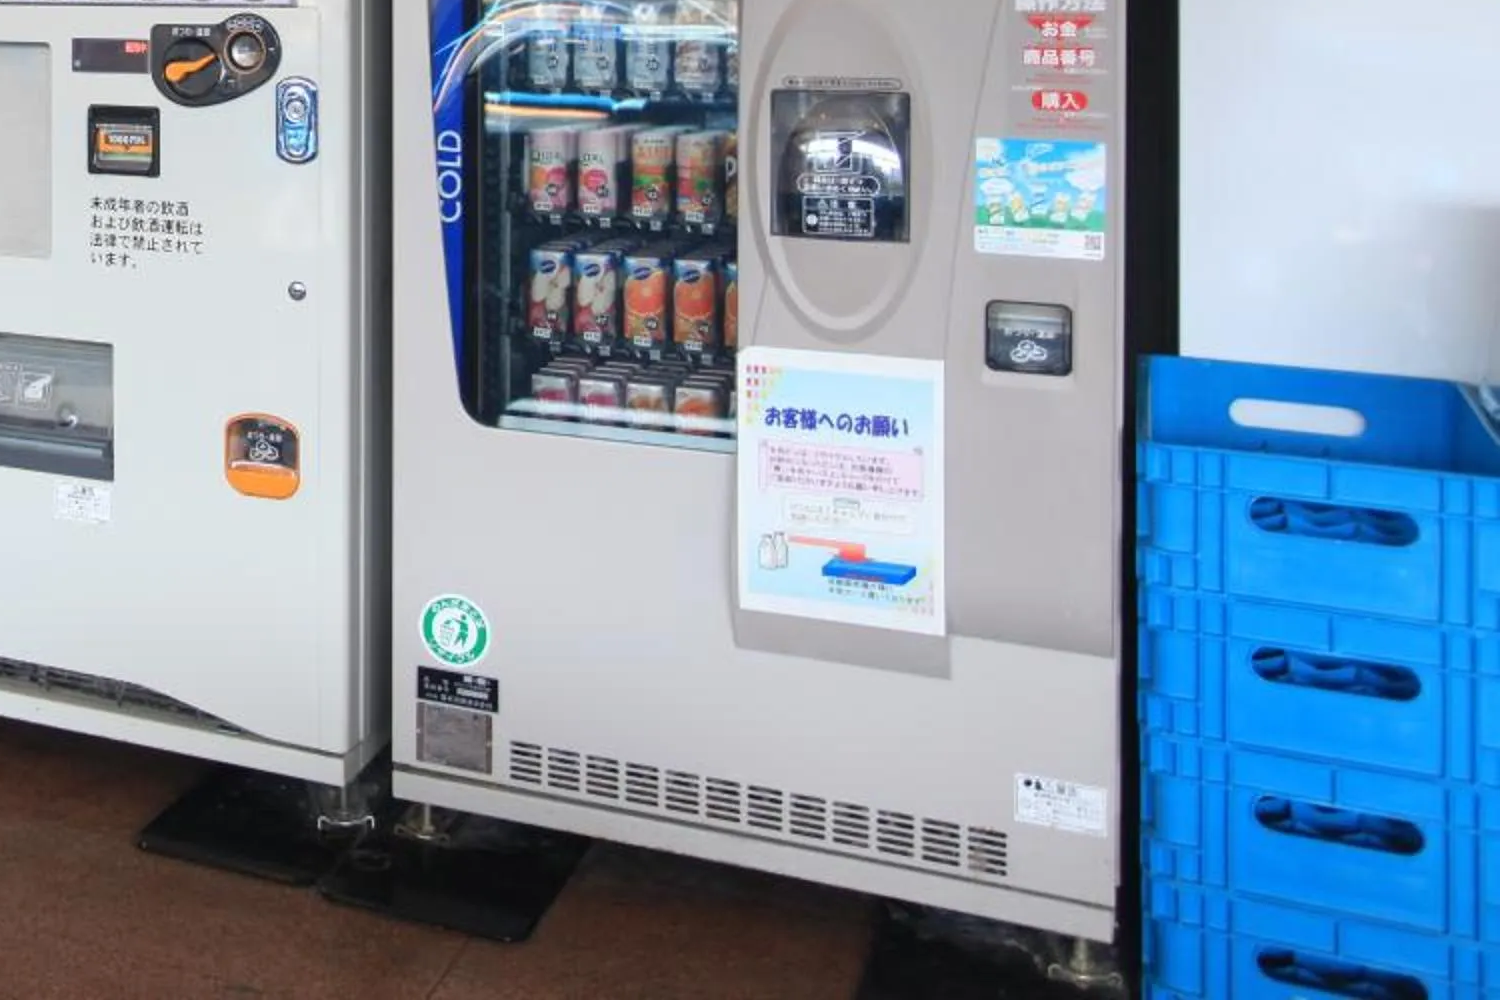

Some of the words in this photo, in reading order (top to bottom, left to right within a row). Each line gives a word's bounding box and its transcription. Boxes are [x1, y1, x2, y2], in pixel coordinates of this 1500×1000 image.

[1041, 20, 1077, 37] お金
[1023, 48, 1095, 66] 商品番号
[1041, 91, 1080, 109] 購入
[436, 128, 462, 224] COLD
[89, 197, 190, 216] 未成年者の飲酒
[90, 215, 204, 236] および飲酒運転は
[89, 233, 204, 254] 法律で禁止されて
[90, 252, 138, 269] います。
[764, 406, 909, 438] お客様へのお願い
